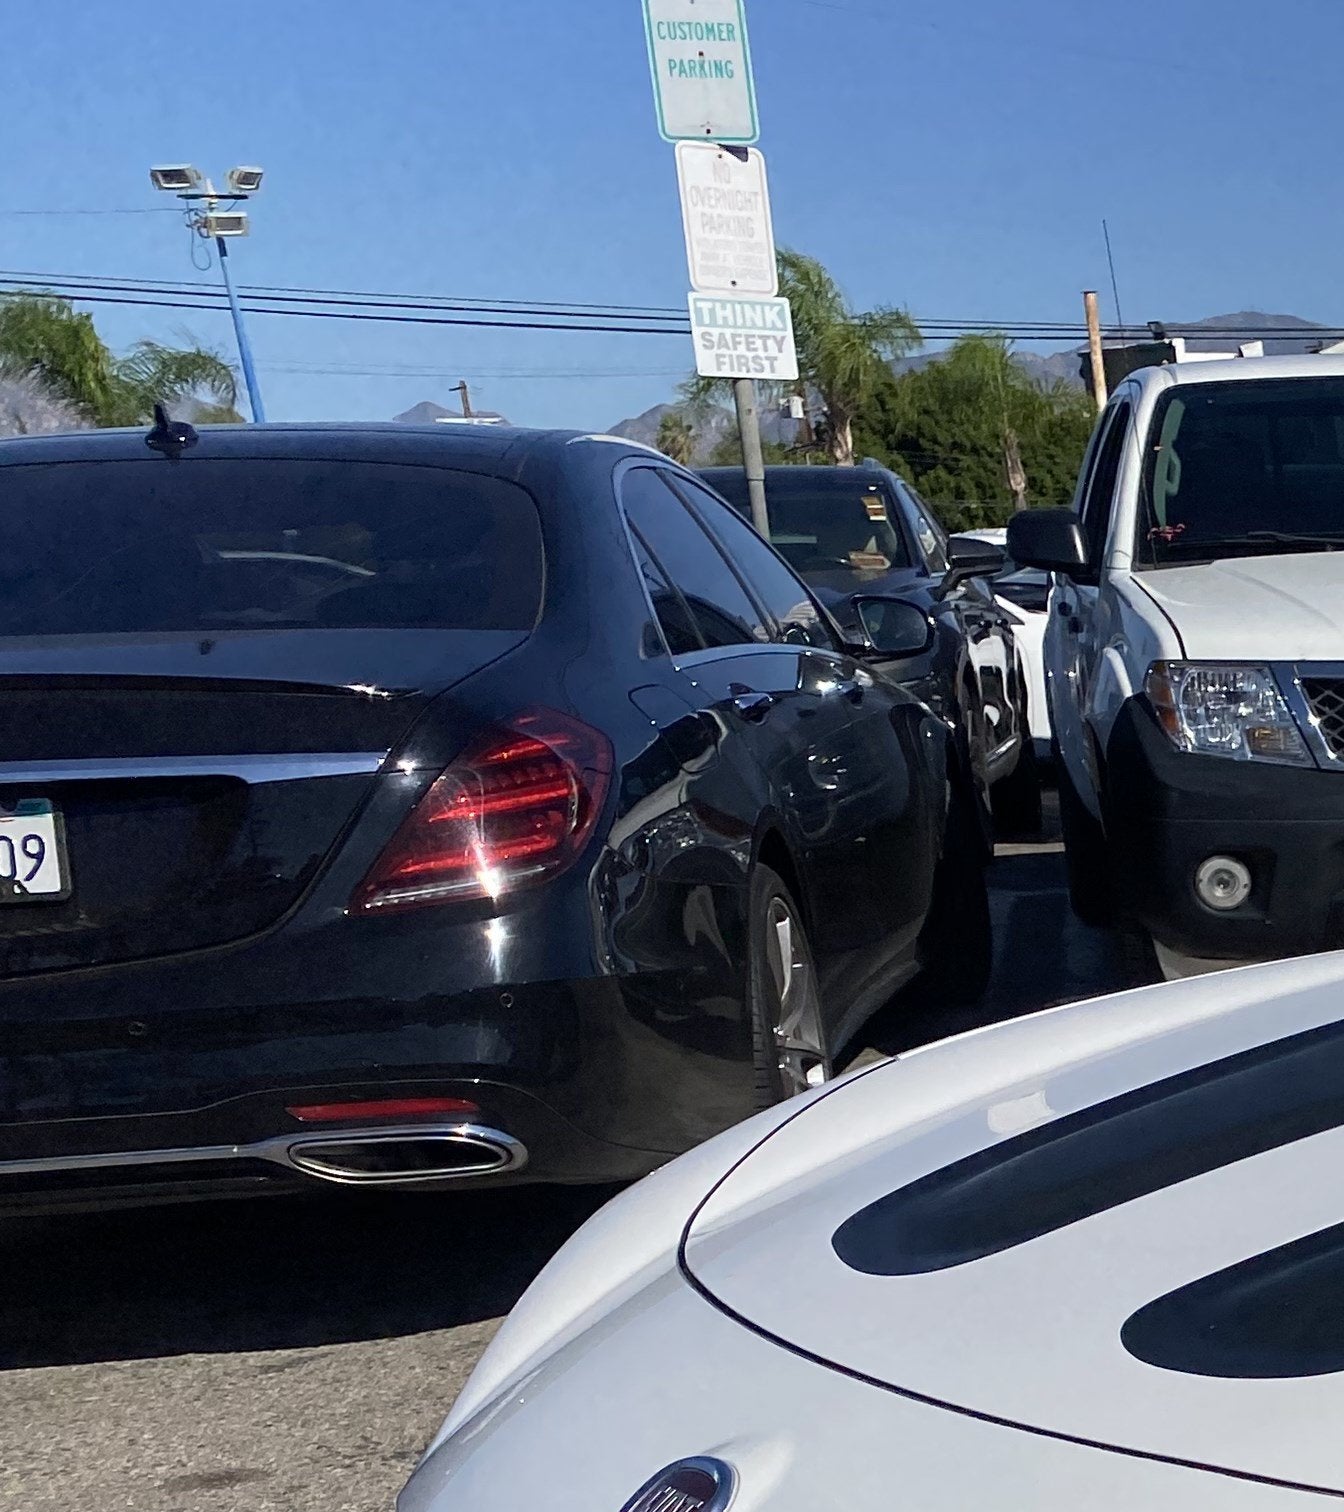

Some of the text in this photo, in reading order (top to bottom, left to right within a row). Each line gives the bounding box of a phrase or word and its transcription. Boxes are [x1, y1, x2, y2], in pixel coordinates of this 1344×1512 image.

[657, 21, 735, 41] CUSTOMER
[668, 58, 734, 79] PARKING
[712, 160, 731, 184] NO
[690, 185, 760, 213] OVERNIGHT
[701, 211, 755, 238] PARKING
[696, 301, 783, 329] THINK
[701, 331, 787, 353] SAFETY
[715, 353, 778, 373] FIRST
